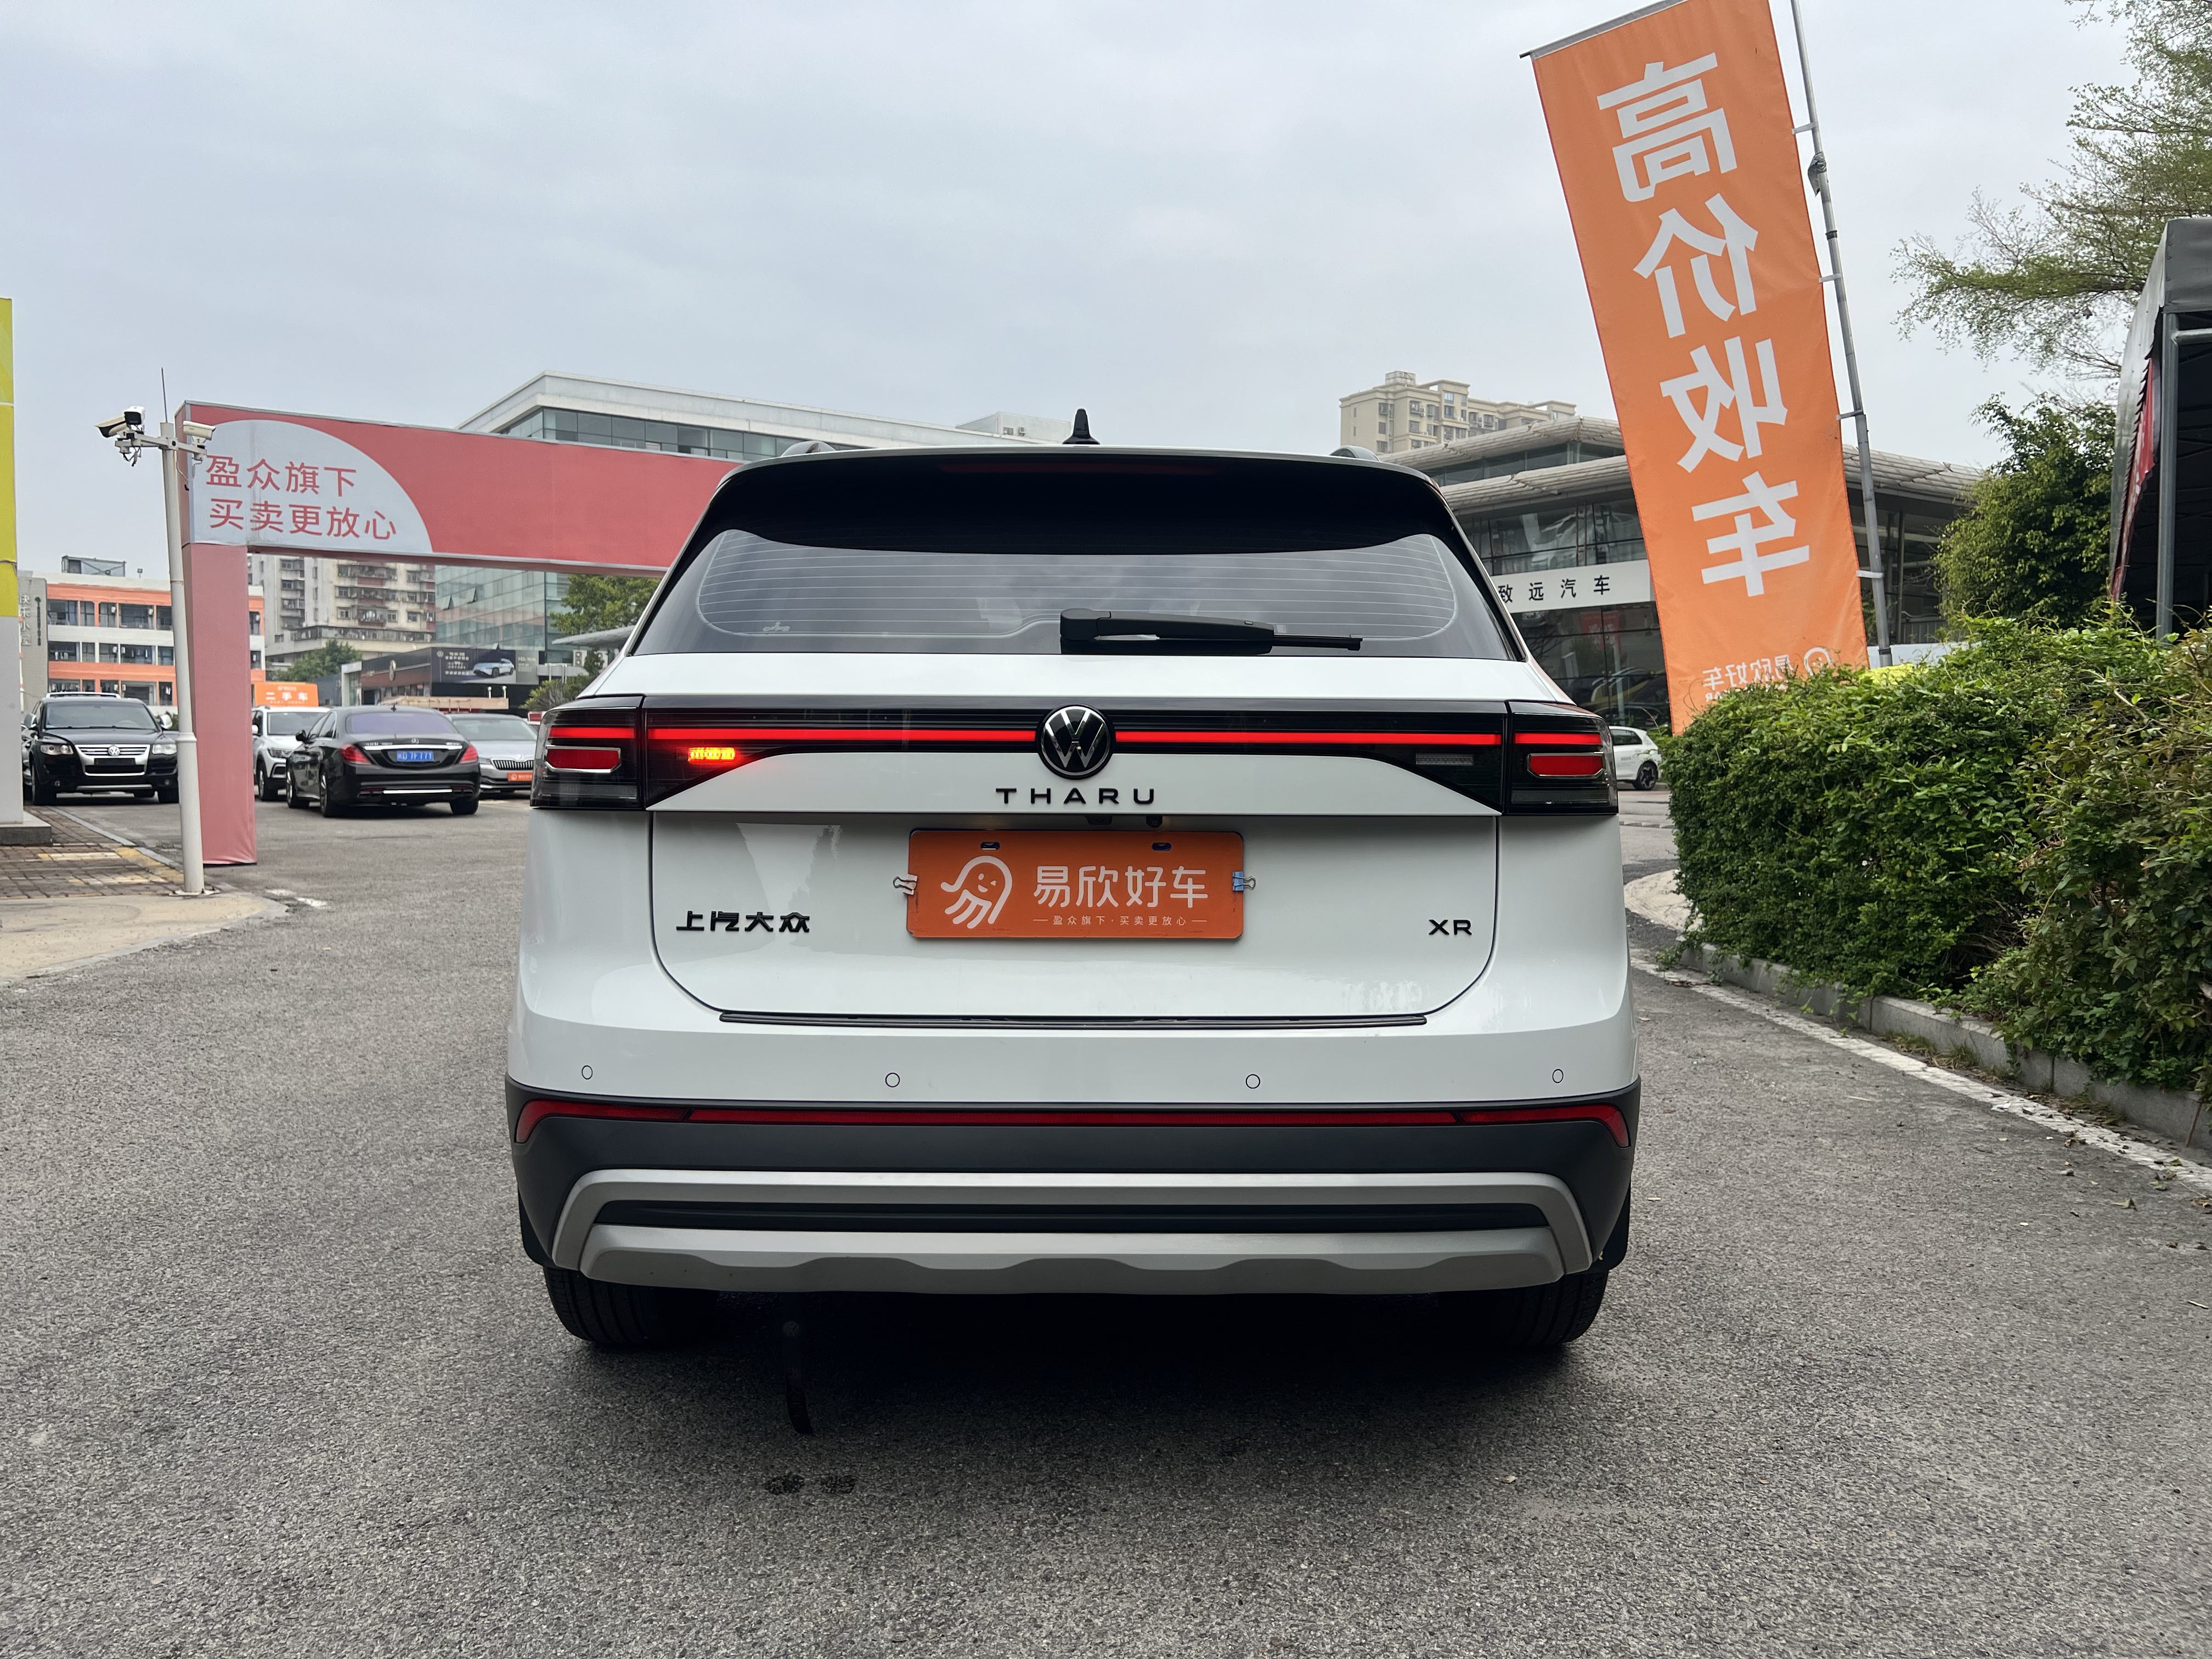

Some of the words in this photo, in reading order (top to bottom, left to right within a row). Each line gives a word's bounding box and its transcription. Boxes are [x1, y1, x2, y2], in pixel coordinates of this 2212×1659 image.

[206, 454, 357, 497] 盈众旗下
[209, 498, 397, 540] 买卖更放心
[1498, 575, 1610, 603] 致远汽车
[266, 692, 308, 701] 二手车
[995, 787, 1155, 805] THARU
[1032, 865, 1208, 909] 易欣好车
[676, 910, 810, 933] 上汽大众
[1429, 919, 1472, 935] XR
